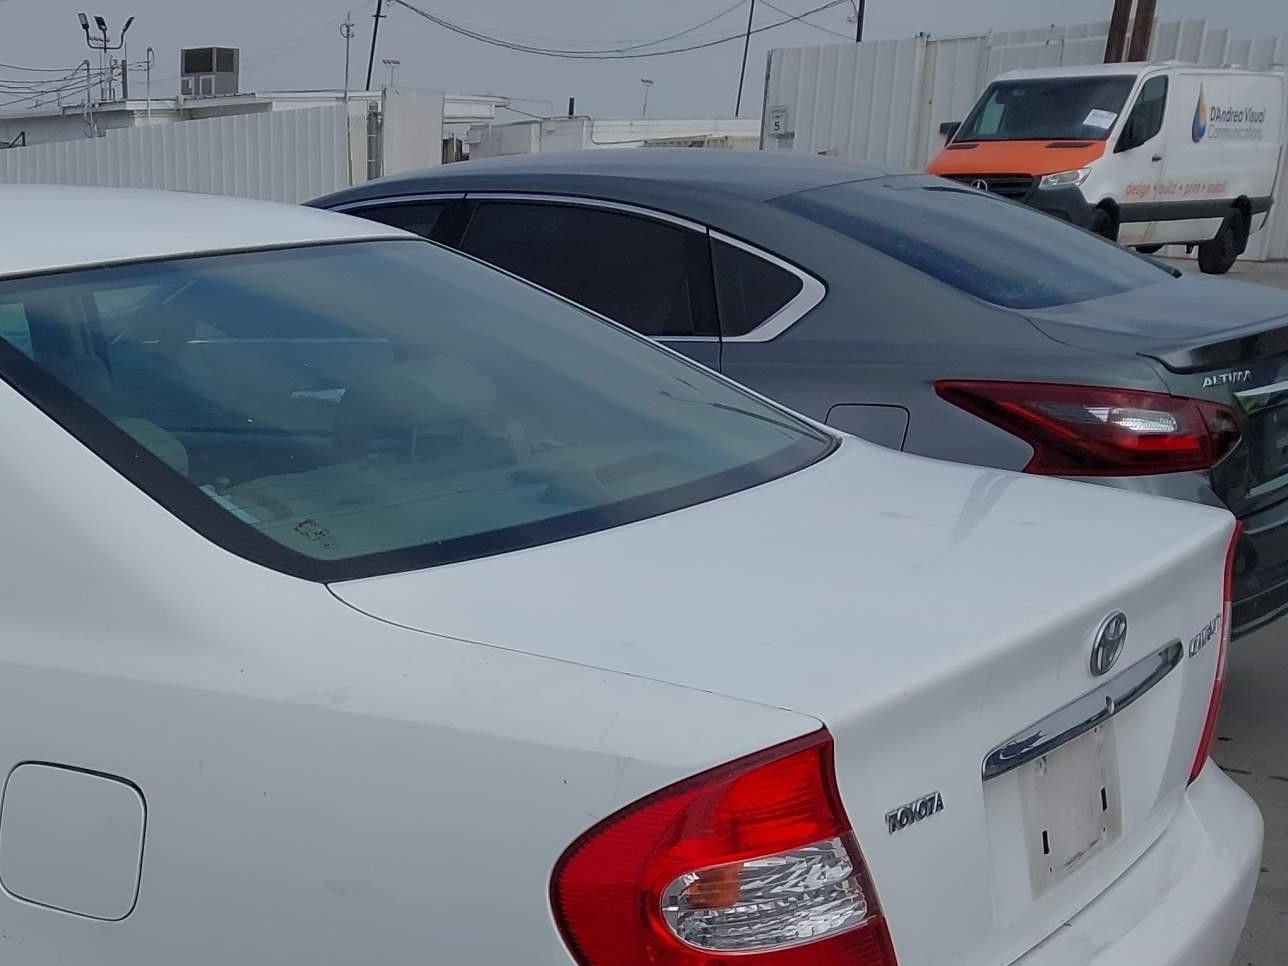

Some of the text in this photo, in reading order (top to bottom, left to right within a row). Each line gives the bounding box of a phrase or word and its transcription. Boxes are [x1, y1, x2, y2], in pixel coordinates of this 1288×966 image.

[773, 120, 781, 131] 5
[1202, 370, 1251, 389] ALTIMA
[885, 790, 945, 835] TOYOTA
